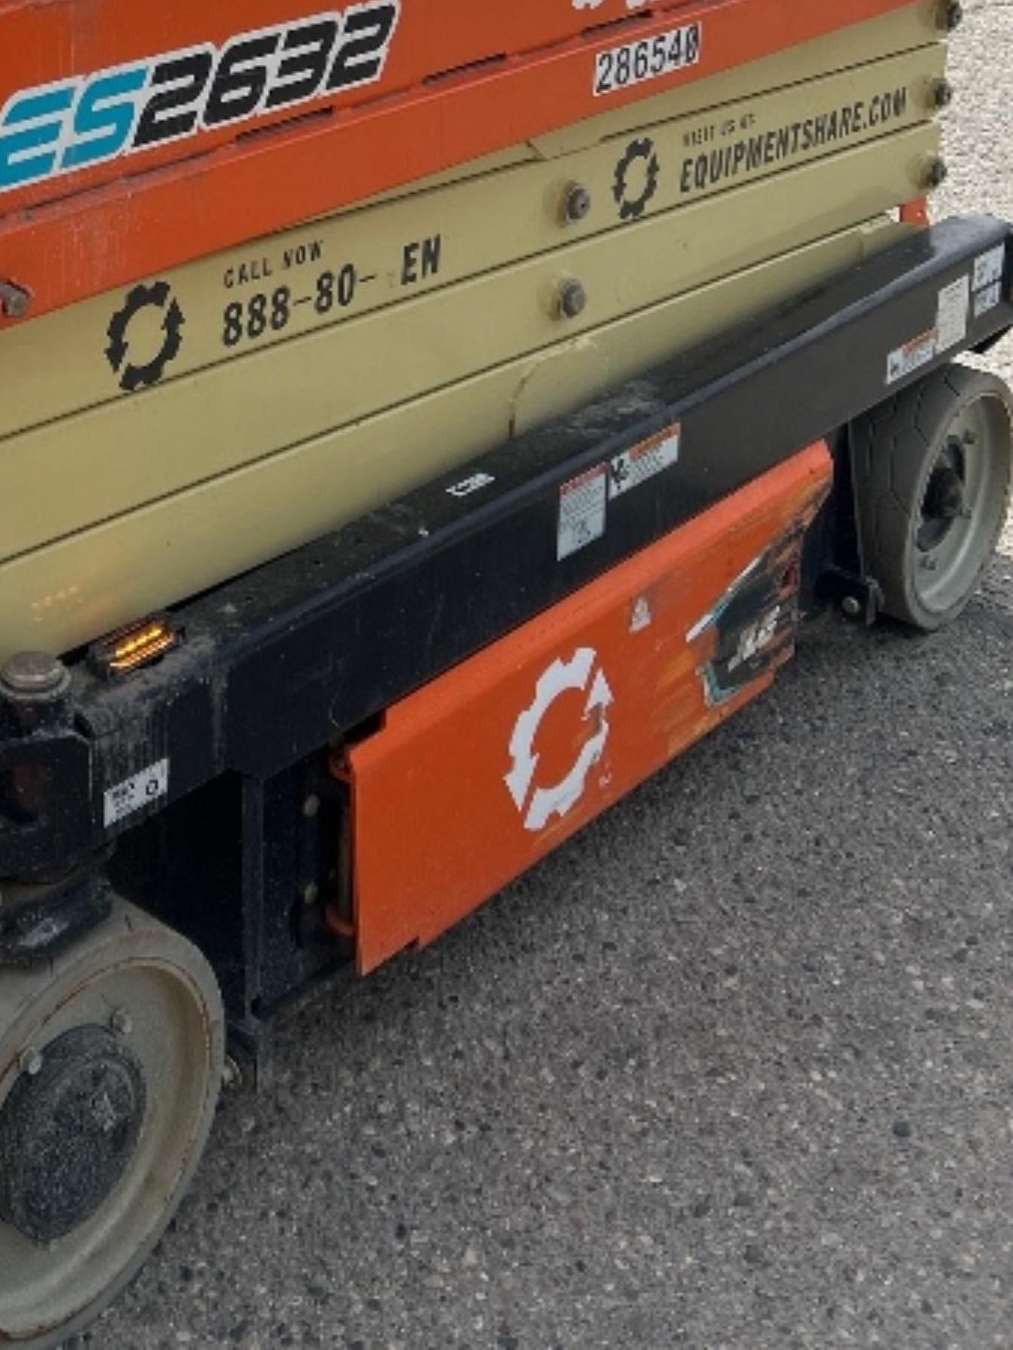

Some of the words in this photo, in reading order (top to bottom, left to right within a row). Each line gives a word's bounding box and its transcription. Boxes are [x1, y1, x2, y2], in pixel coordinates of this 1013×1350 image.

[596, 26, 698, 92] 286540
[680, 87, 906, 191] EQUIPMENTSHARE.COM
[224, 258, 272, 289] CALL
[282, 240, 323, 270] NOW
